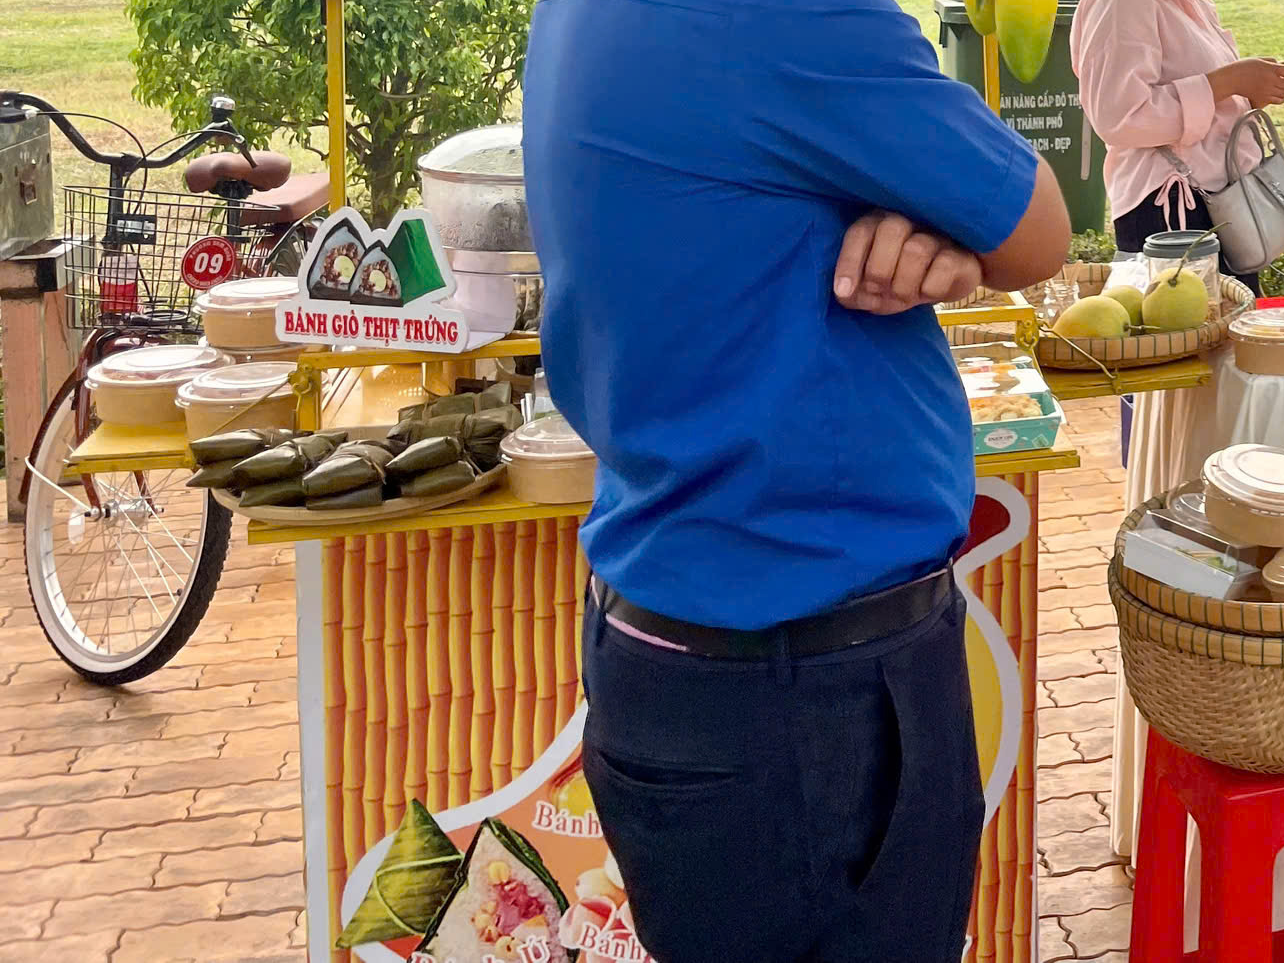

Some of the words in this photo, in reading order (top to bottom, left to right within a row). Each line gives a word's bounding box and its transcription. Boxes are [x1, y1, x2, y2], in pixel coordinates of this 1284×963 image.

[1016, 114, 1045, 130] THÀNH
[1046, 111, 1063, 129] PHỐ
[194, 252, 223, 274] 09
[285, 307, 328, 334] BÁNH
[331, 310, 360, 337] GIÒ
[362, 316, 400, 346] THỊT
[403, 315, 459, 343] TRỨNG
[535, 803, 601, 836] Bánh
[579, 923, 642, 961] Bánh
